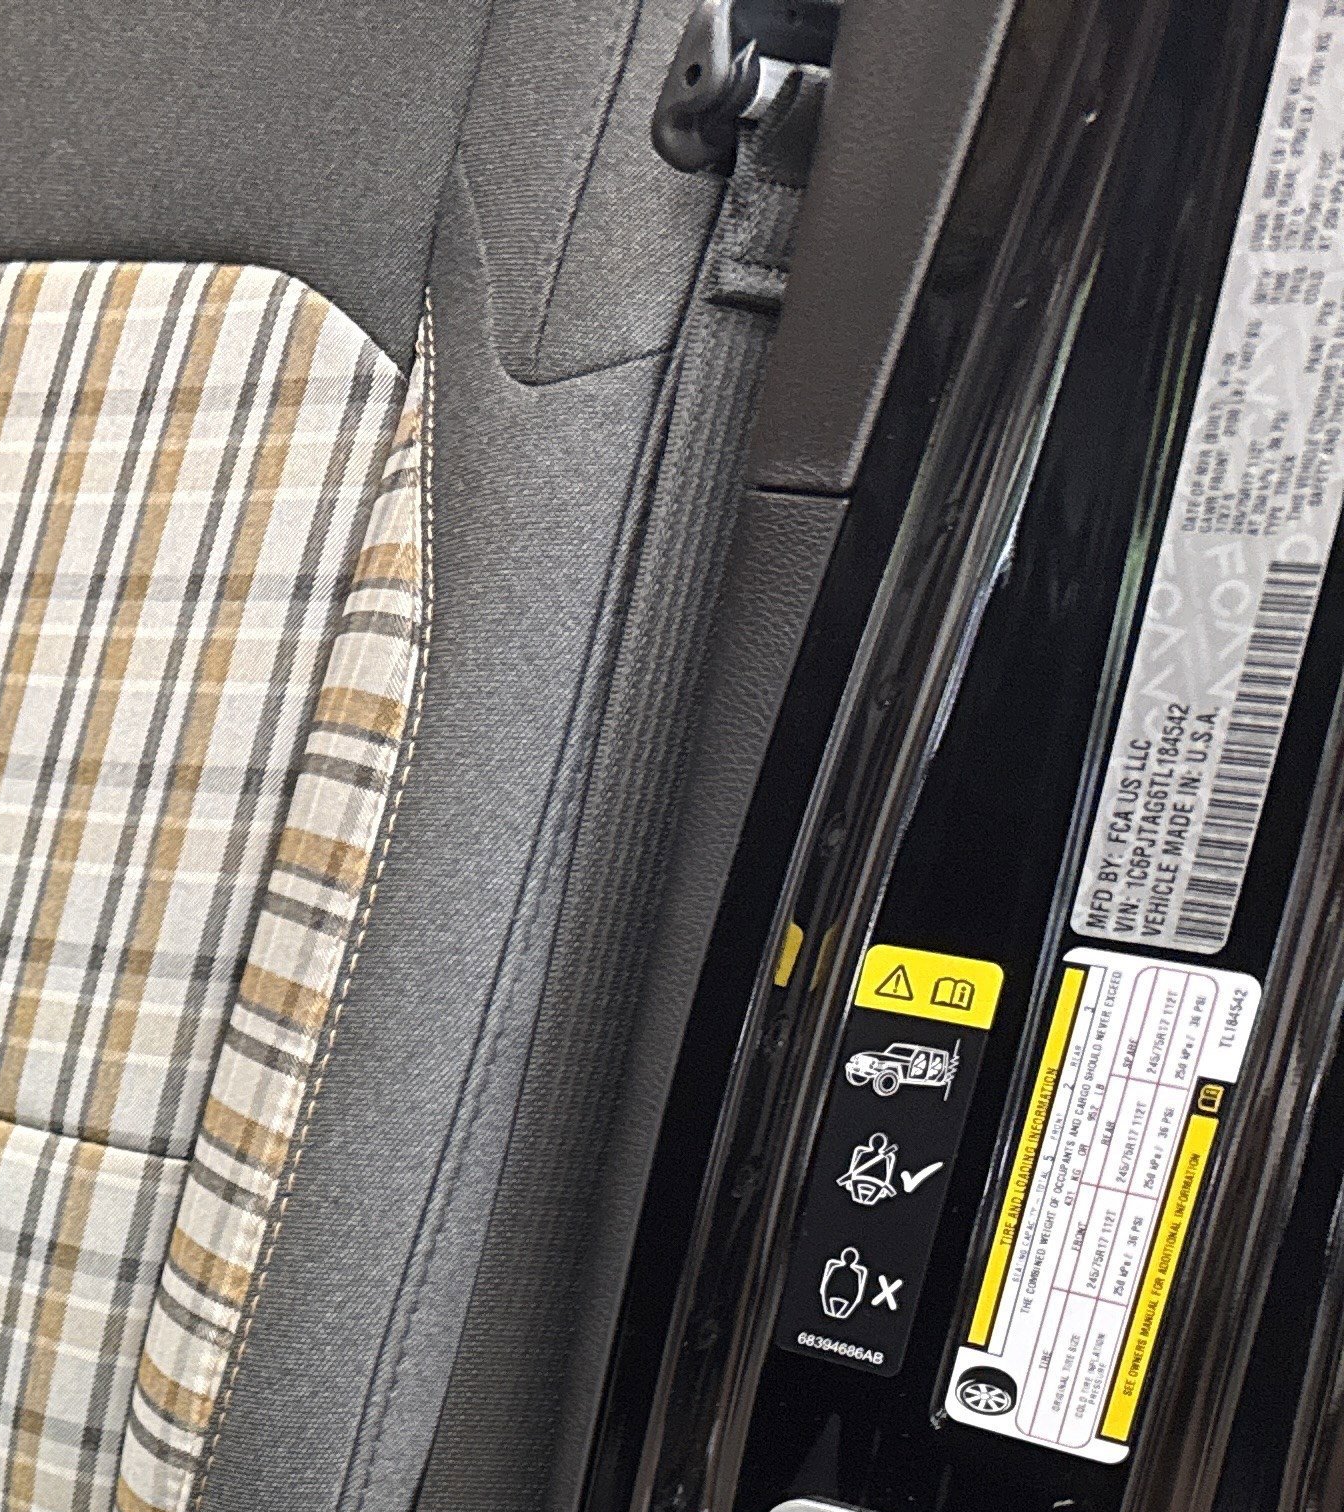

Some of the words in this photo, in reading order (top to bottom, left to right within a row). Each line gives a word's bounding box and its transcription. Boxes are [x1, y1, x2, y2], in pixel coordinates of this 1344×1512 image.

[1183, 703, 1220, 764] U.S.A.
[1123, 736, 1153, 772] LLC
[1115, 775, 1143, 804] US
[1122, 701, 1191, 891] 1C6PJTAG6TL184542
[1175, 767, 1204, 796] IN:
[1105, 807, 1135, 845] FCA
[1160, 800, 1195, 857] MADE
[1095, 851, 1124, 884] BY:
[1084, 887, 1115, 930] MFD
[1111, 894, 1142, 935] VIN:
[1139, 860, 1180, 940] VEHICLE
[1102, 969, 1123, 1008] EXCEED
[1093, 1008, 1112, 1041] NEVER
[1082, 1042, 1103, 1082] SHOULD
[1026, 1066, 1059, 1143] INFORMATION
[1073, 1082, 1092, 1116] CARGO
[1067, 1117, 1083, 1137] AND
[1013, 1145, 1037, 1194] LOADING
[1051, 1139, 1077, 1195] OCCUPANTS
[1172, 1151, 1202, 1218] INFORMATION
[1006, 1195, 1024, 1219] AND
[1047, 1195, 1061, 1209] OF
[998, 1220, 1017, 1247] TIRE
[1037, 1209, 1057, 1246] WEIGHT
[1084, 1236, 1110, 1290] 245/75R17
[1100, 1208, 1118, 1234] 112T
[1155, 1220, 1182, 1275] ADDITIONAL
[1024, 1247, 1047, 1295] COMBINED
[1149, 1275, 1166, 1297] FOR
[1019, 1295, 1034, 1314] THE
[1137, 1297, 1160, 1338] MANUAL
[797, 1331, 884, 1365] 68394686AB
[1126, 1337, 1148, 1378] OWNERS
[1120, 1378, 1136, 1397] SEE
